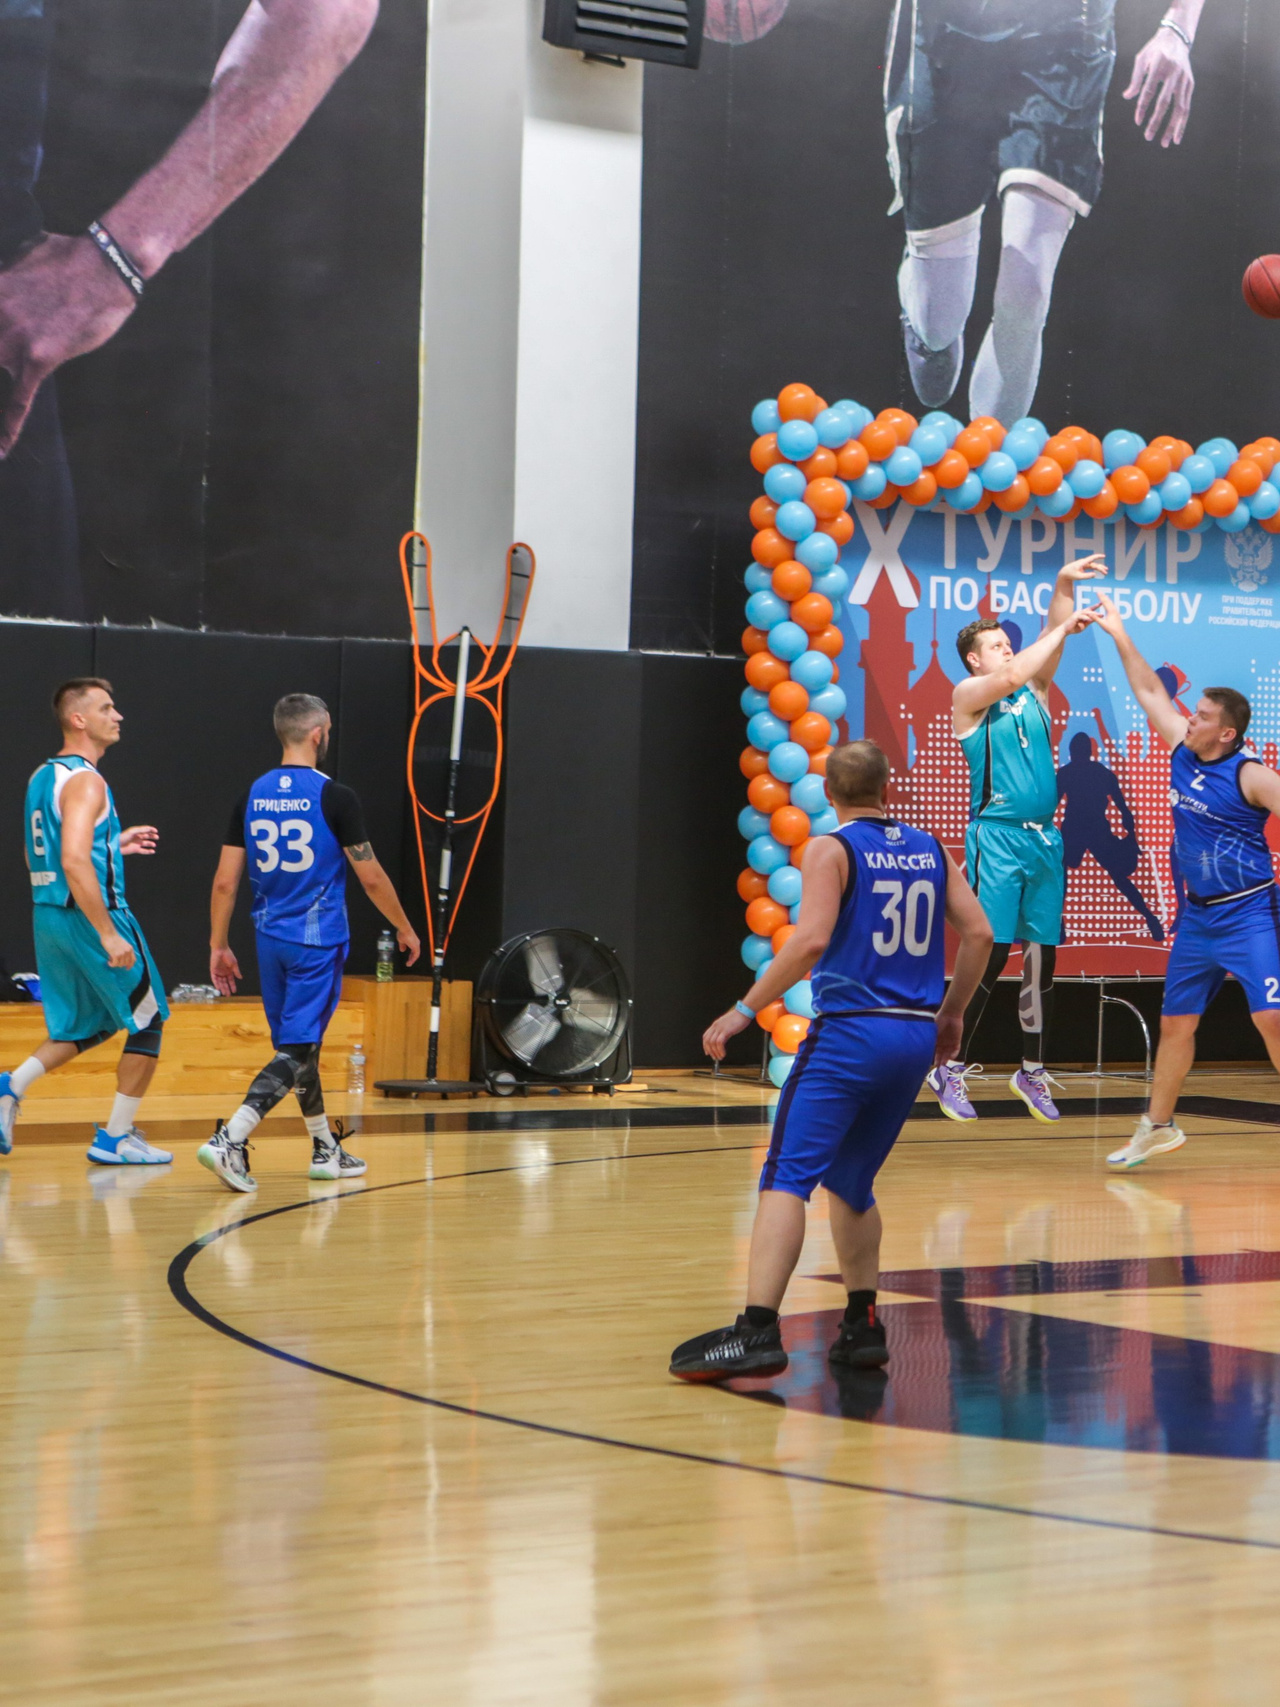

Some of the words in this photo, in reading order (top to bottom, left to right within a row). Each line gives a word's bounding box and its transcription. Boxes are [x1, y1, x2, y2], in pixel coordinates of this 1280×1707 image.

[931, 501, 1202, 584] ТУРНИР
[930, 576, 979, 611] ПО
[990, 579, 1202, 624] БАСЕТБОЛУ
[253, 798, 312, 813] ГРИЦЕНКО
[250, 818, 315, 873] 33
[872, 879, 936, 957] 30
[1264, 976, 1280, 1003] 2
